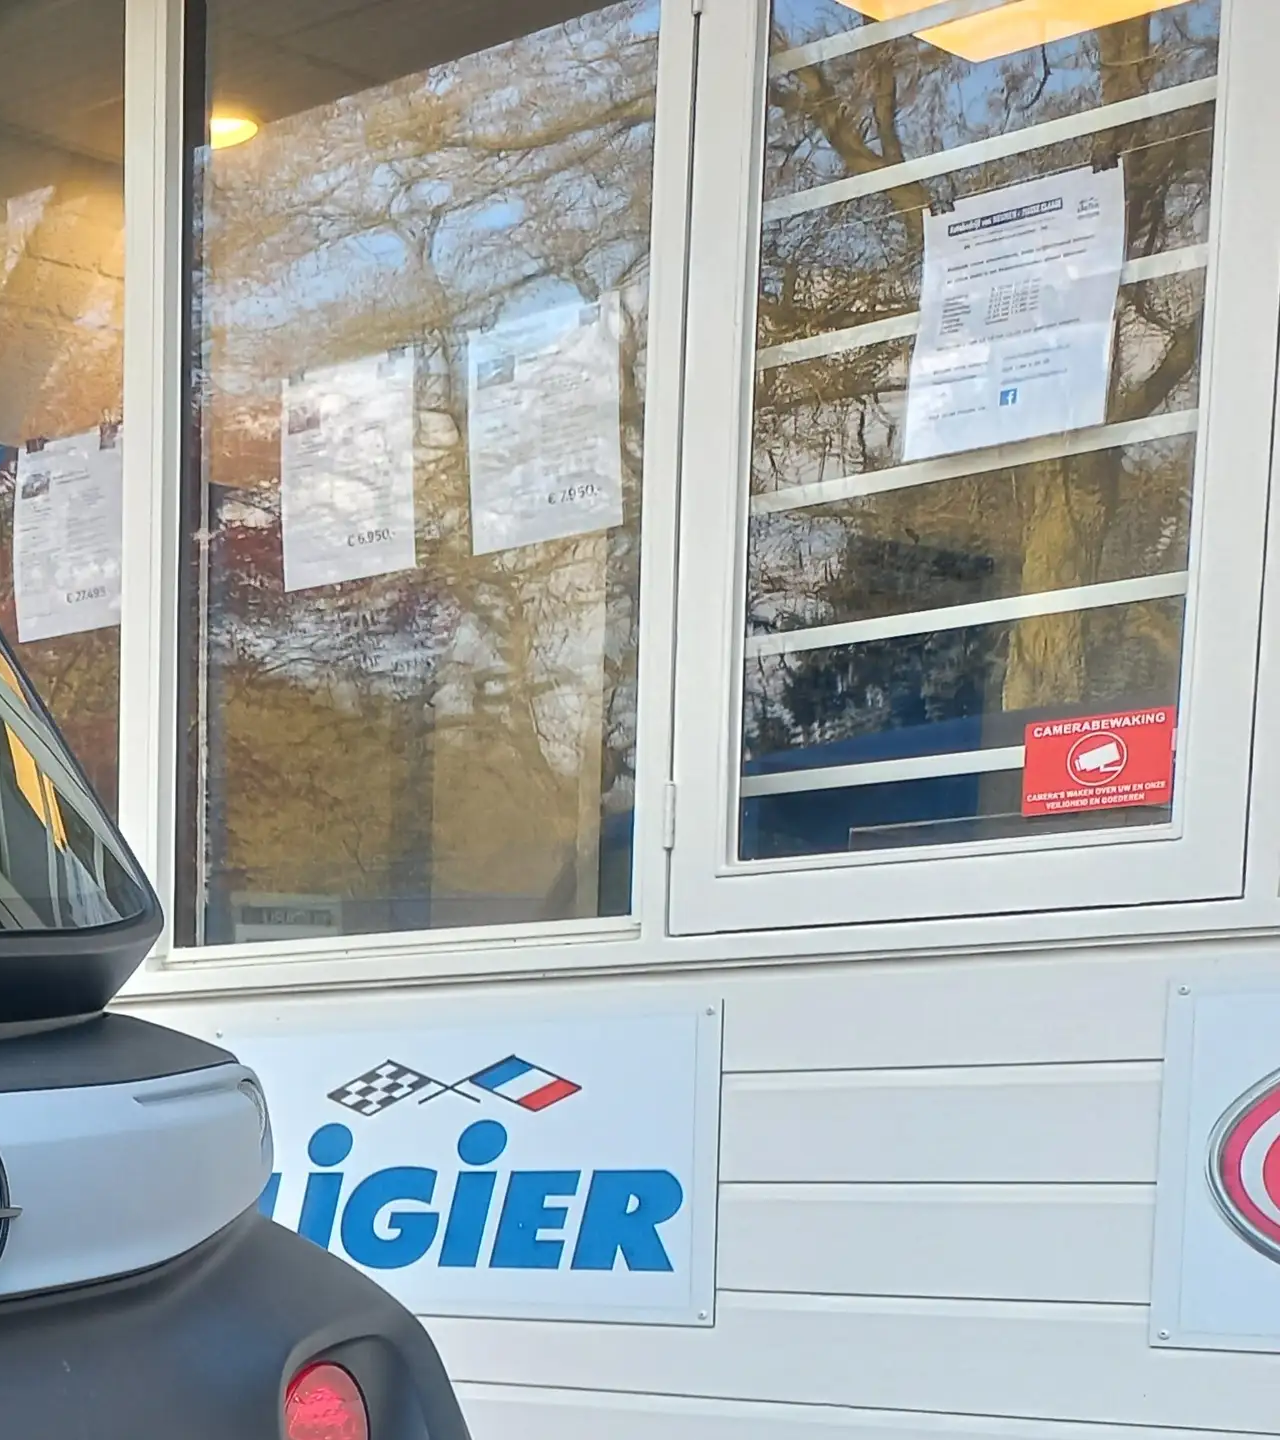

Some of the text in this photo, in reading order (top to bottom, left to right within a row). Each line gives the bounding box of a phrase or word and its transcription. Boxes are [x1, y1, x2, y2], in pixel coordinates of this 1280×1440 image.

[1033, 711, 1166, 738] CAMERABEWAKING
[1026, 780, 1166, 803] CAMERA'S WAKEN OVER UW EN ONZE
[1089, 797, 1101, 807] EN
